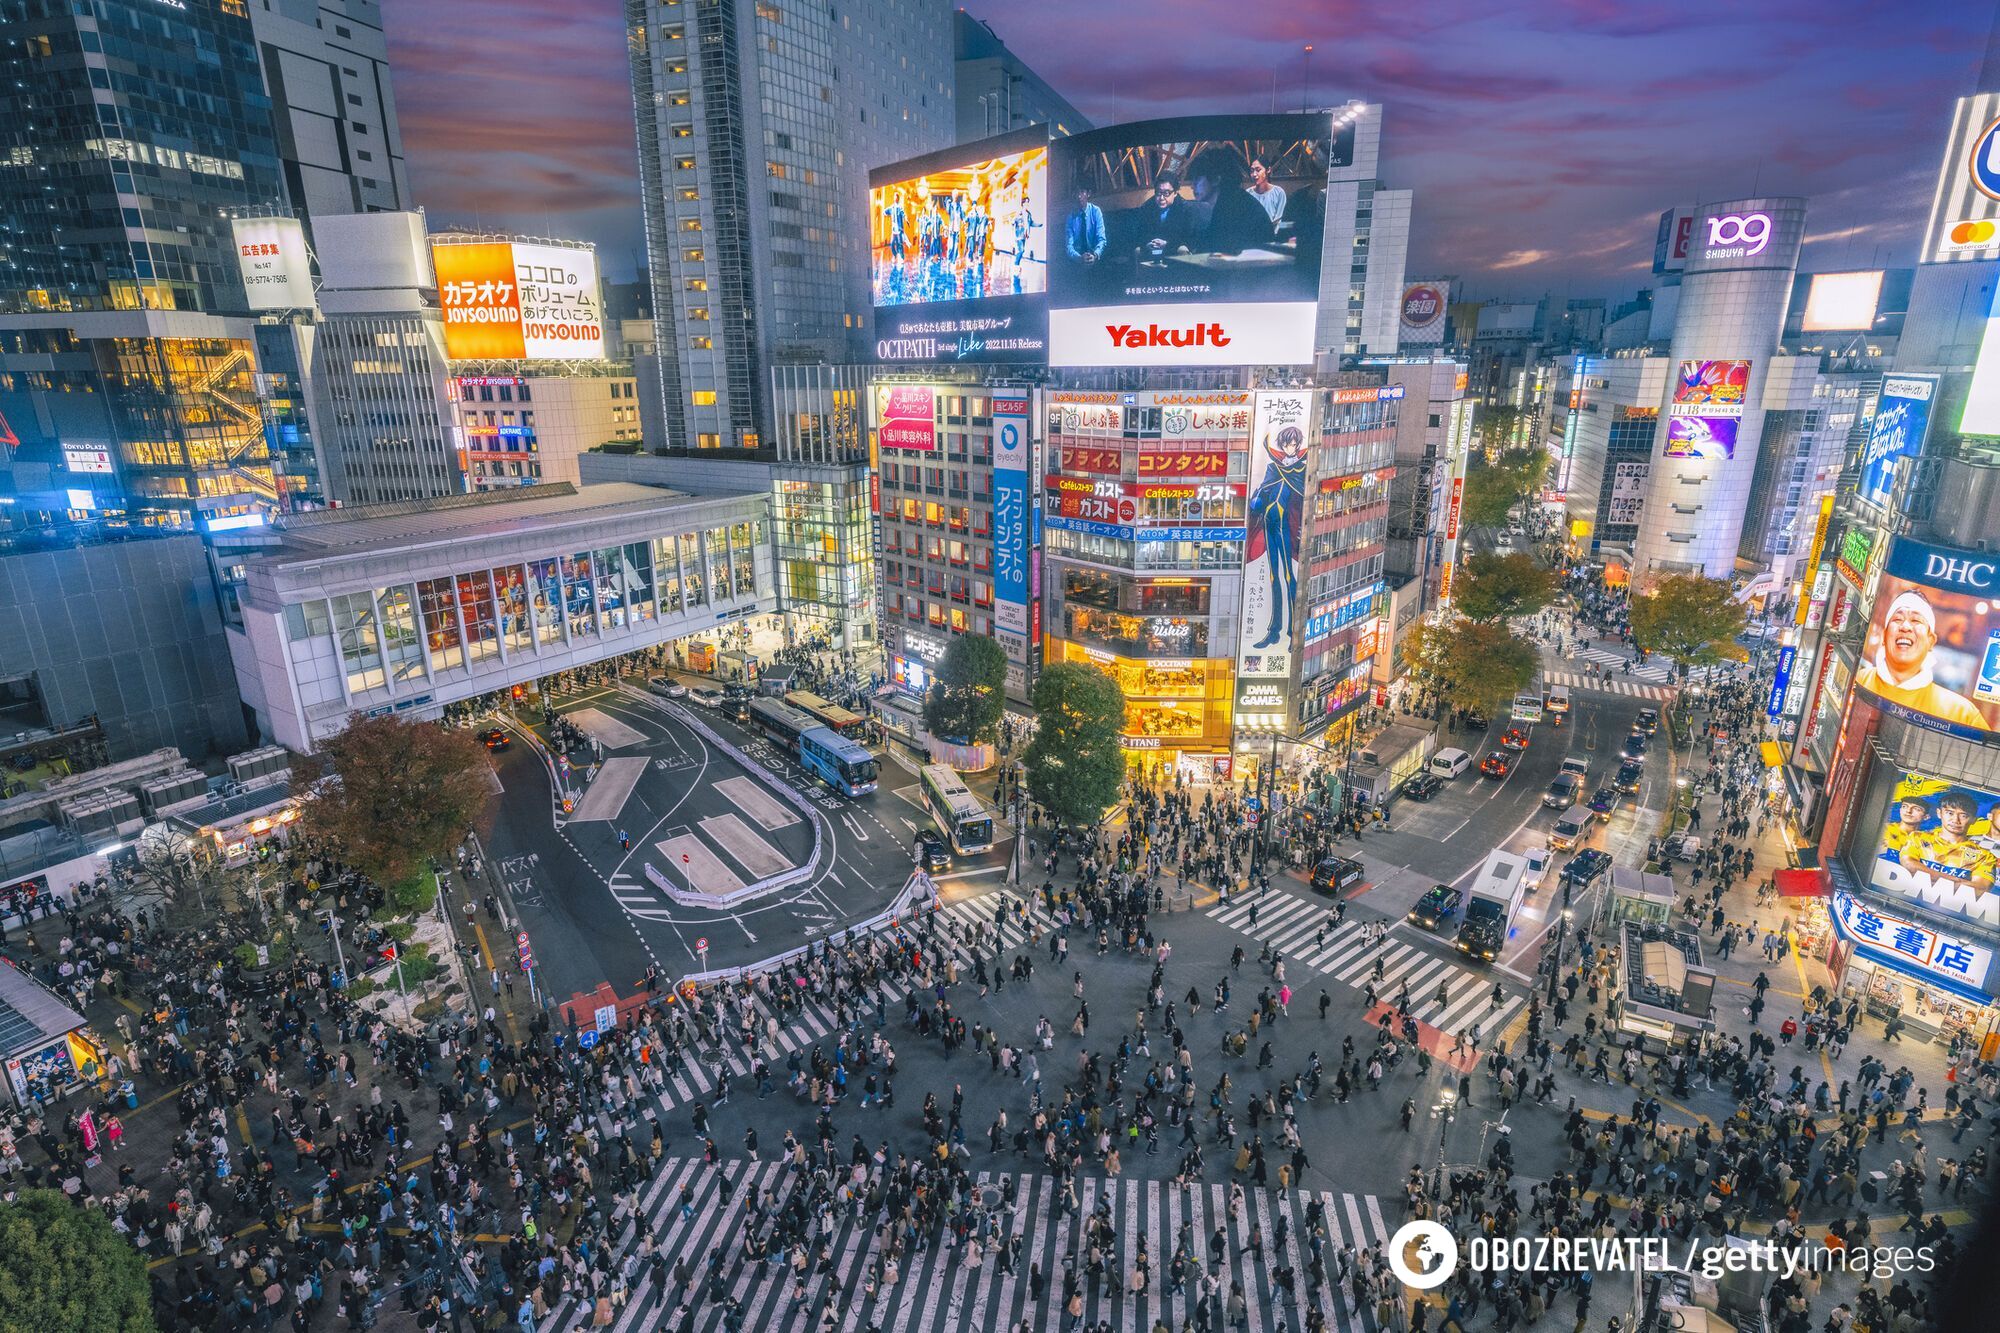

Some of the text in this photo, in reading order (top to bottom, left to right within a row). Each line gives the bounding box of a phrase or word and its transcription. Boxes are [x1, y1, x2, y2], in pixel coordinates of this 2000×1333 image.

[1707, 213, 1772, 256] 109
[241, 244, 279, 256] 広告募集
[1705, 248, 1743, 259] SHIBUYA
[245, 275, 287, 284] 03-5774-7505
[518, 264, 577, 285] ココロの
[443, 280, 514, 305] カラオケ
[447, 306, 519, 323] JOYSOUND
[523, 306, 599, 322] あげていこう。
[1405, 299, 1436, 314] 楽園
[525, 323, 600, 340] JOYSOUND
[1106, 323, 1231, 348] Yakult
[877, 338, 936, 359] OCTPATH
[958, 331, 984, 359] Like
[985, 339, 1017, 349] 2022.11.16
[1018, 338, 1043, 349] Release
[901, 392, 931, 403] 品川スキン
[901, 403, 928, 415] クリニック
[1672, 405, 1700, 415] 11.18
[1049, 413, 1061, 424] 9F
[1082, 411, 1119, 428] しゃぶ葉
[1192, 411, 1248, 429] しゃぶ葉
[887, 428, 932, 445] 品川美容外科
[1460, 420, 1470, 455] CAMERA
[997, 452, 1023, 465] eyecity
[1063, 449, 1120, 468] プライス
[1140, 454, 1225, 472] コンタクト
[1094, 481, 1124, 498] ガスト
[1197, 485, 1237, 500] ガスト
[1048, 495, 1061, 508] 7F
[1080, 499, 1115, 519] ガスト
[996, 487, 1011, 581] アイシティ
[1012, 489, 1023, 583] コンタクトの
[1068, 520, 1118, 536] 英会話イーオン
[1171, 530, 1244, 540] 英会話イーオン
[1924, 554, 1995, 587] DHC
[1350, 660, 1370, 680] LUSH
[1246, 684, 1279, 695] DMM
[1240, 694, 1284, 706] GAMES
[1913, 708, 1951, 731] Channel
[1870, 857, 2000, 926] DMM
